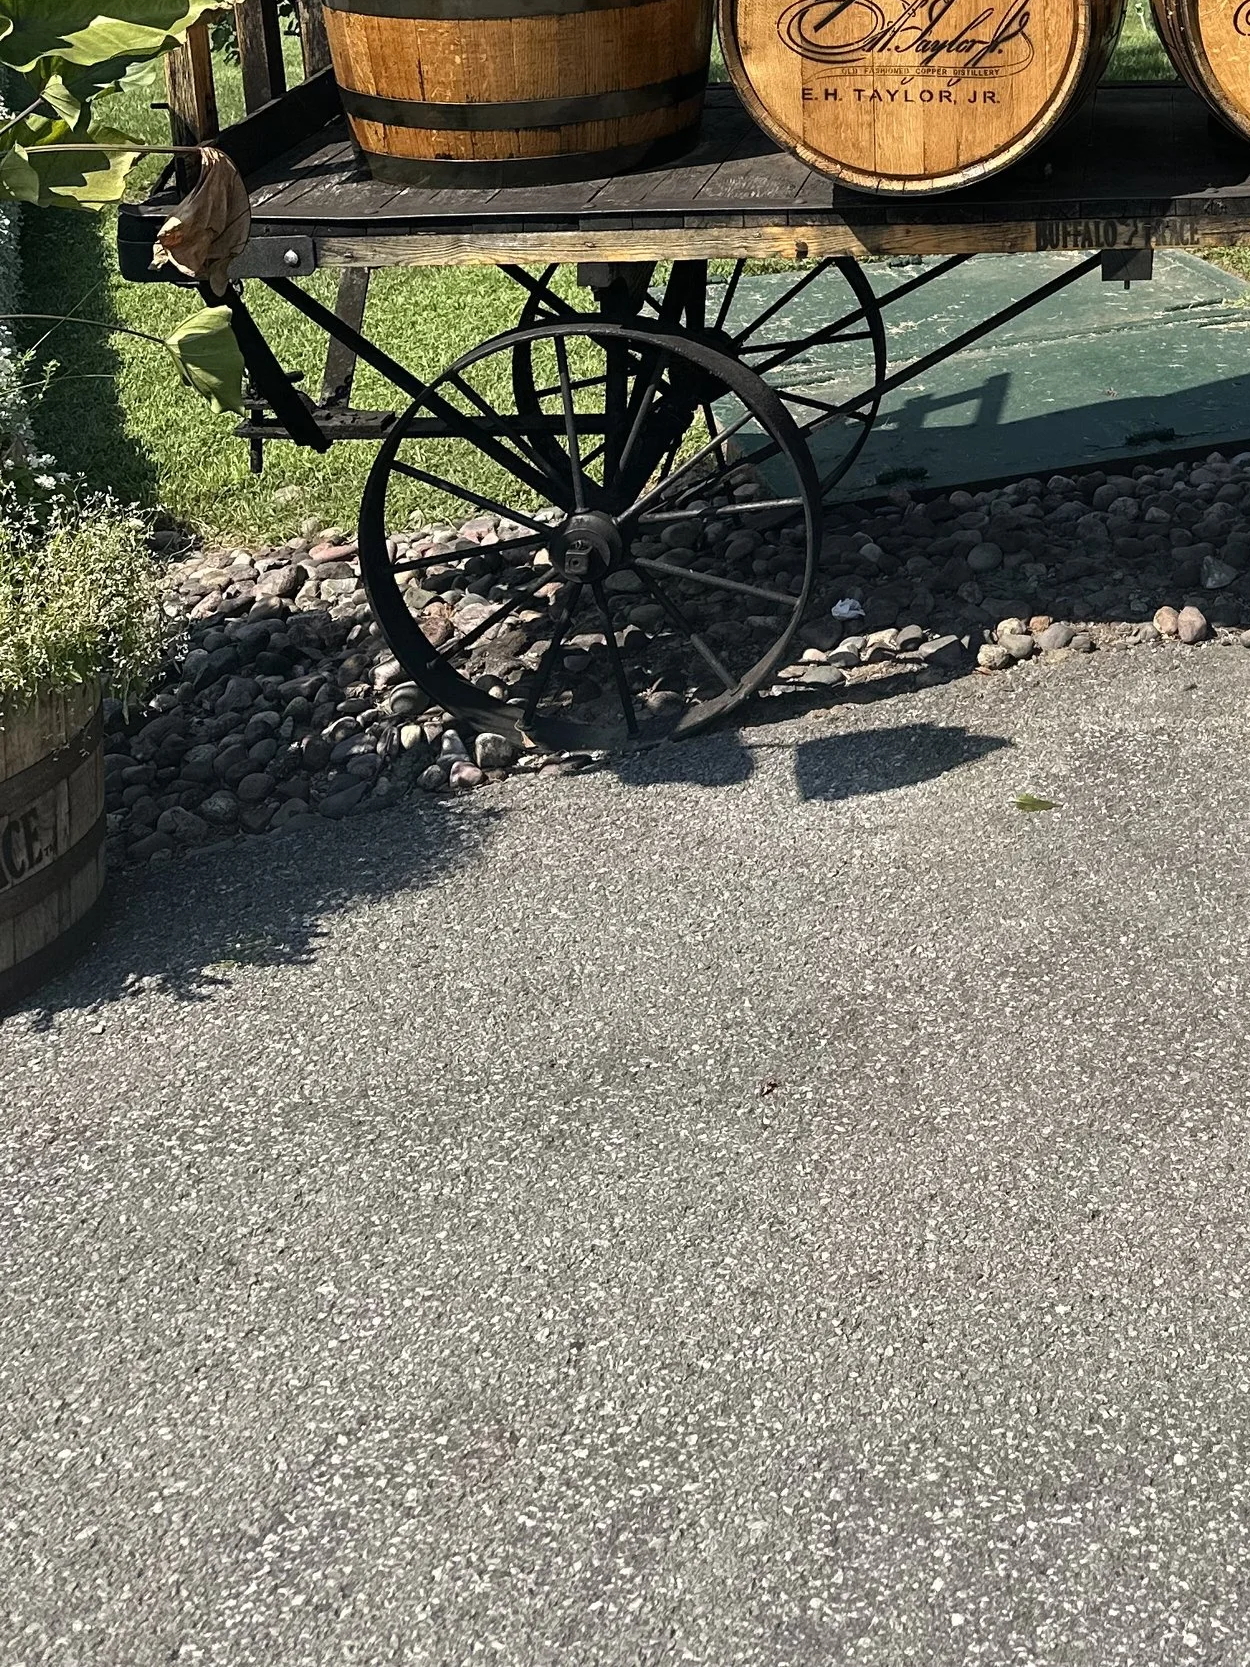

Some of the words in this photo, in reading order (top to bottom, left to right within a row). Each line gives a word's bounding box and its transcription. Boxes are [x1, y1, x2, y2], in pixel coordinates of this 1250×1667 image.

[915, 67, 947, 76] COPPER
[953, 68, 1000, 77] DISTILLERY
[853, 88, 957, 105] TAYLOR,
[967, 90, 1001, 104] JR.
[1036, 220, 1118, 251] BUFFALO
